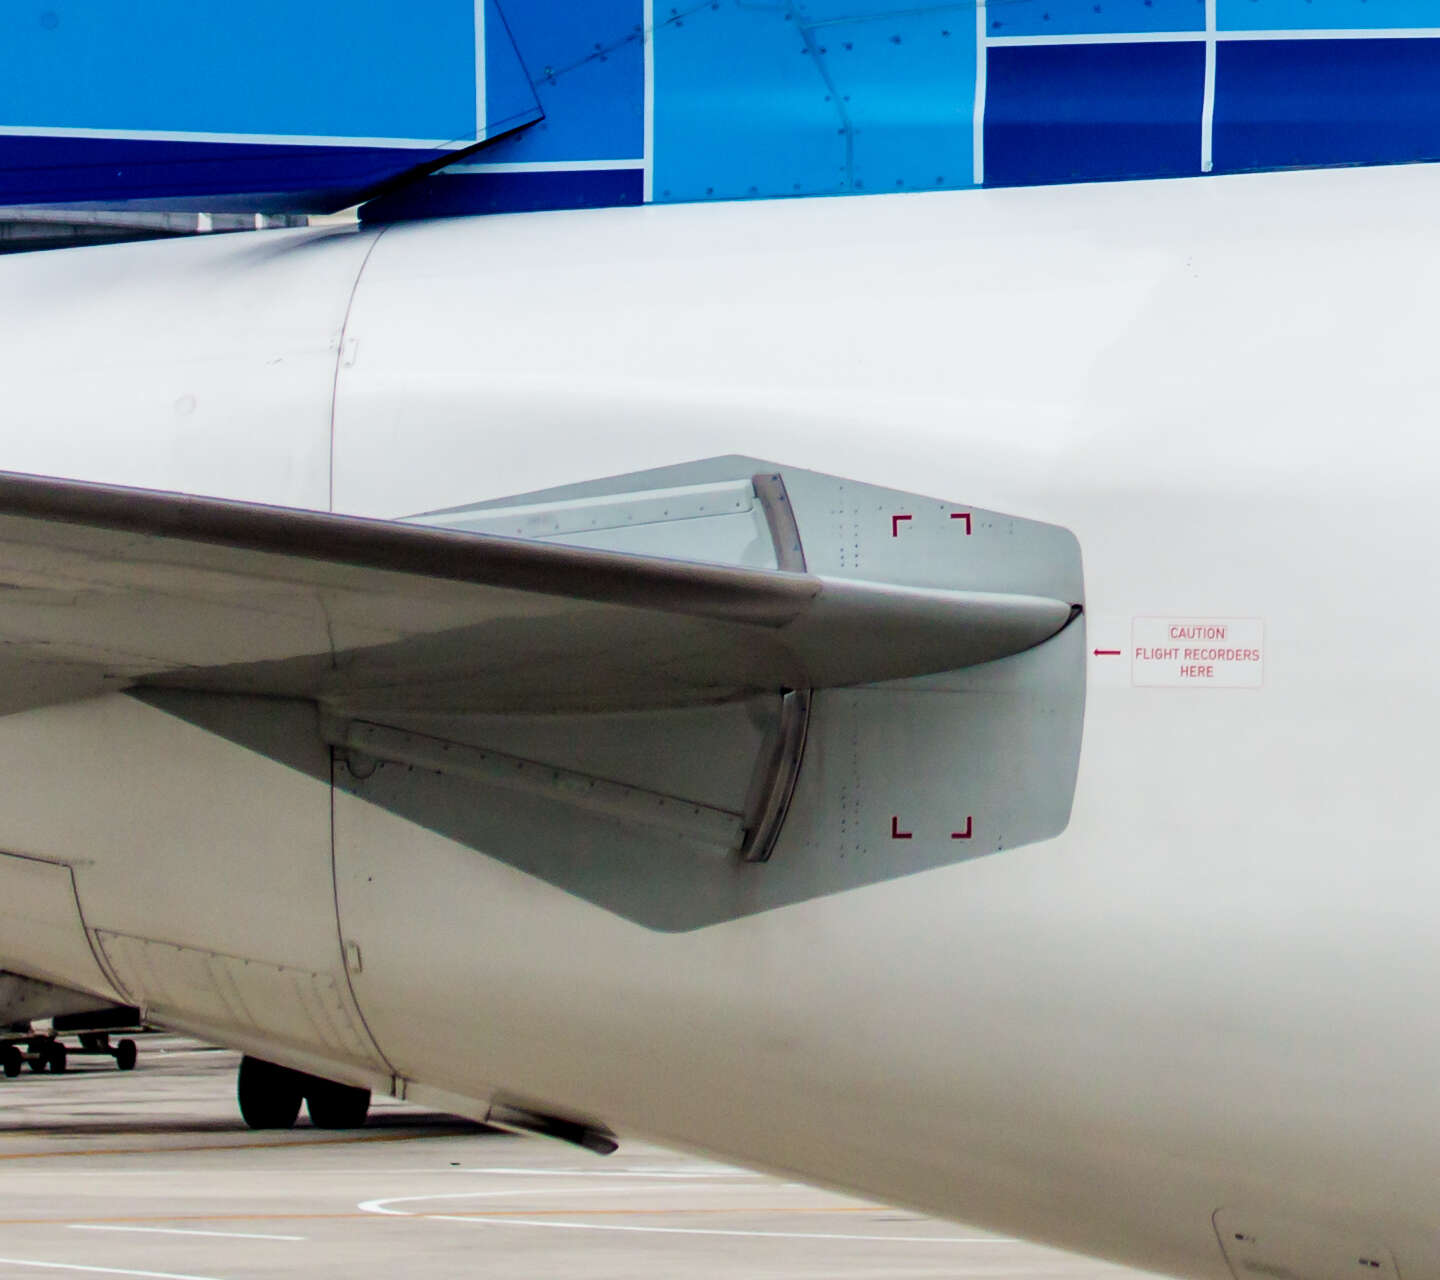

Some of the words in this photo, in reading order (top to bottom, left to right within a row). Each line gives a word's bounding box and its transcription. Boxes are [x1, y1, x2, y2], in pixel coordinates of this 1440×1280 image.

[1169, 626, 1225, 640] CAUTION
[1135, 647, 1180, 660] FLIGHT
[1183, 648, 1260, 662] RECORDERS
[1180, 665, 1214, 678] HERE
